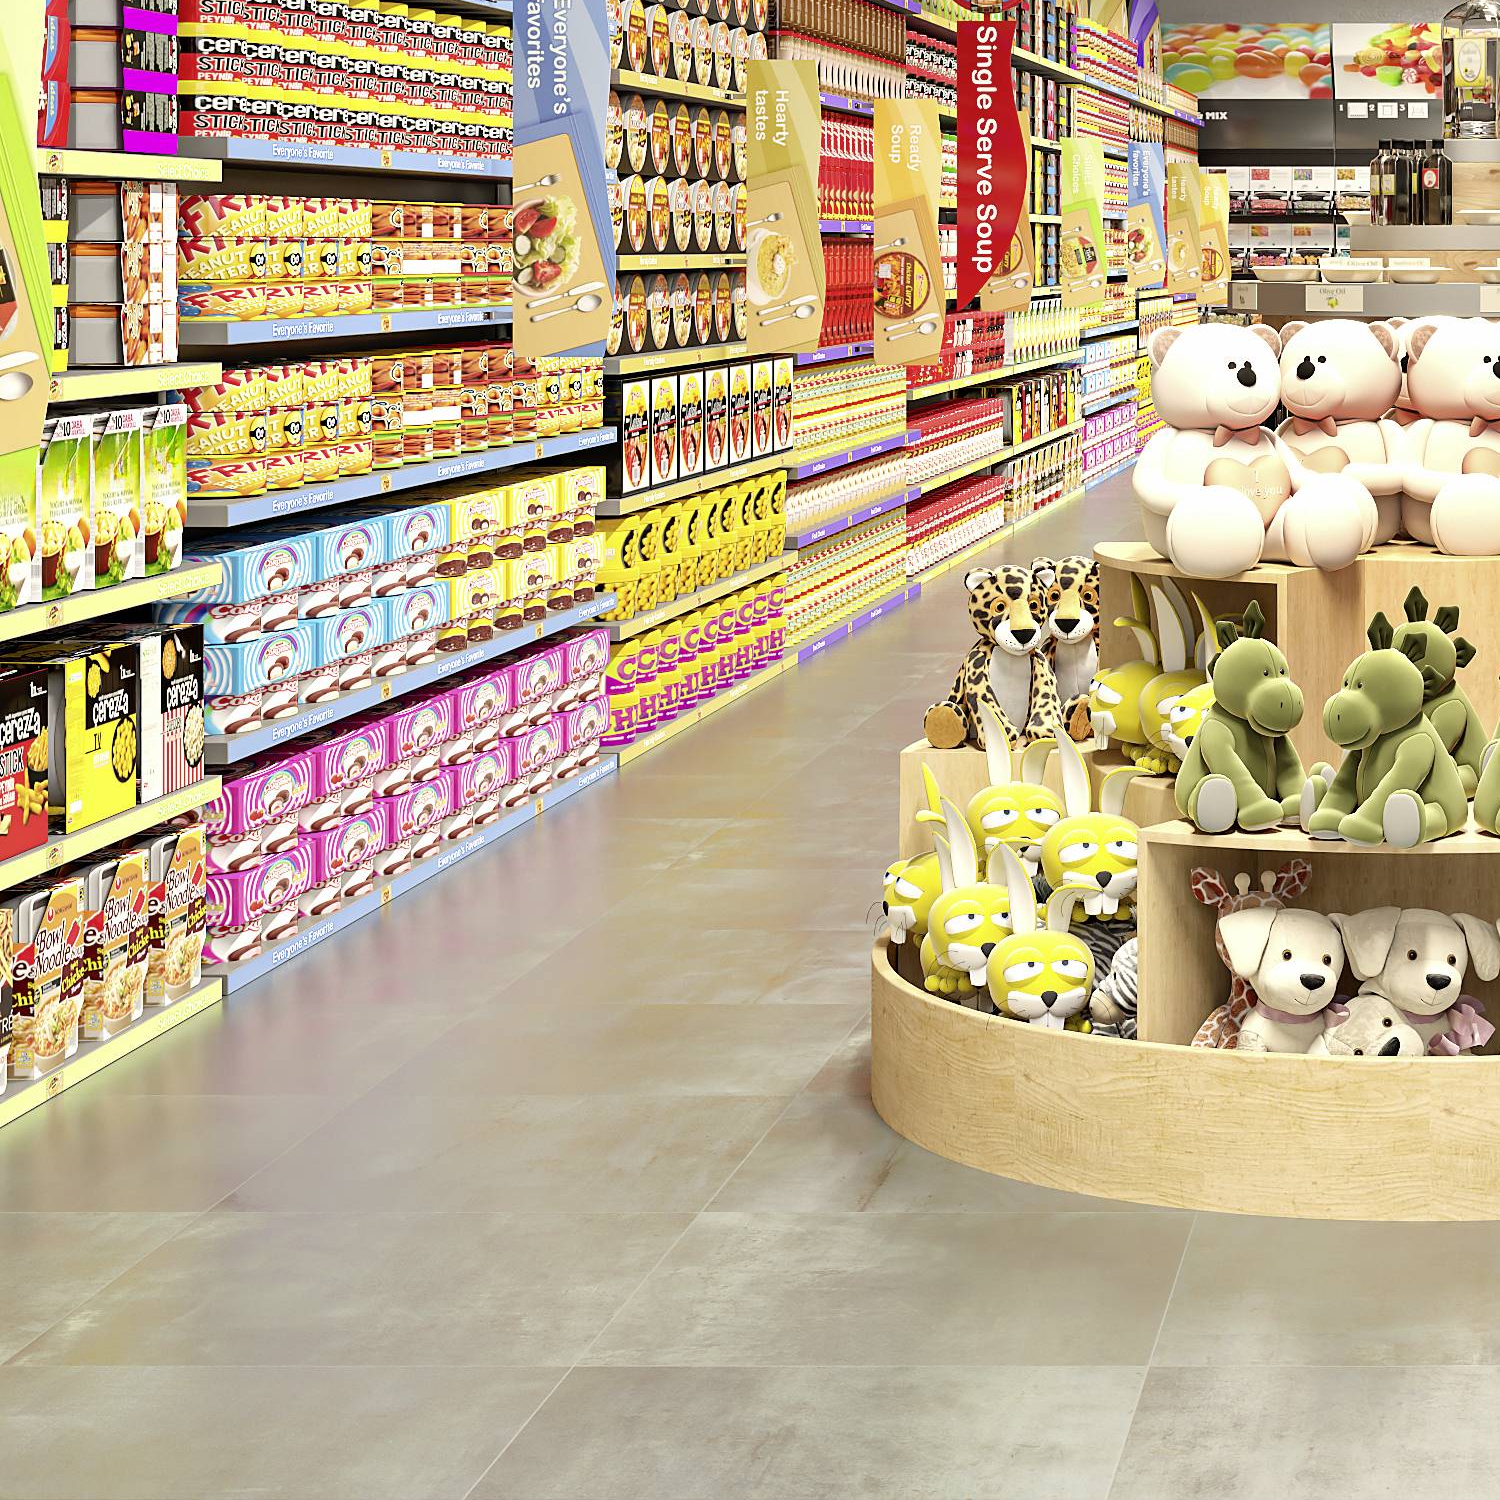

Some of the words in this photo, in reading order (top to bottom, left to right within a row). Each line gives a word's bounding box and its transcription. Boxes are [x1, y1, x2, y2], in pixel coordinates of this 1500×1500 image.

[971, 26, 998, 110] Single
[755, 90, 769, 141] tastes
[772, 90, 789, 147] Hearty
[1206, 112, 1228, 120] MIX
[272, 142, 307, 159] Everyone's
[308, 147, 334, 160] Favorite
[889, 124, 904, 164] Soup
[907, 124, 922, 172] Ready
[976, 118, 998, 196] Serve
[1132, 150, 1141, 187] favorites
[1142, 150, 1153, 197] Everyone's
[972, 204, 998, 273] Soup
[1319, 287, 1334, 295] Olive
[1336, 287, 1346, 295] Oil
[272, 322, 307, 339] Everyone's
[308, 321, 334, 334] Favorite
[272, 495, 307, 513] Everyone's
[308, 489, 334, 504] Favorite
[272, 718, 308, 741] Everyone's
[308, 708, 334, 726] Favorite
[105, 887, 132, 919] Bowl
[36, 921, 64, 951] Bowl
[272, 934, 308, 965] Everyone's
[308, 920, 334, 945] Favorite
